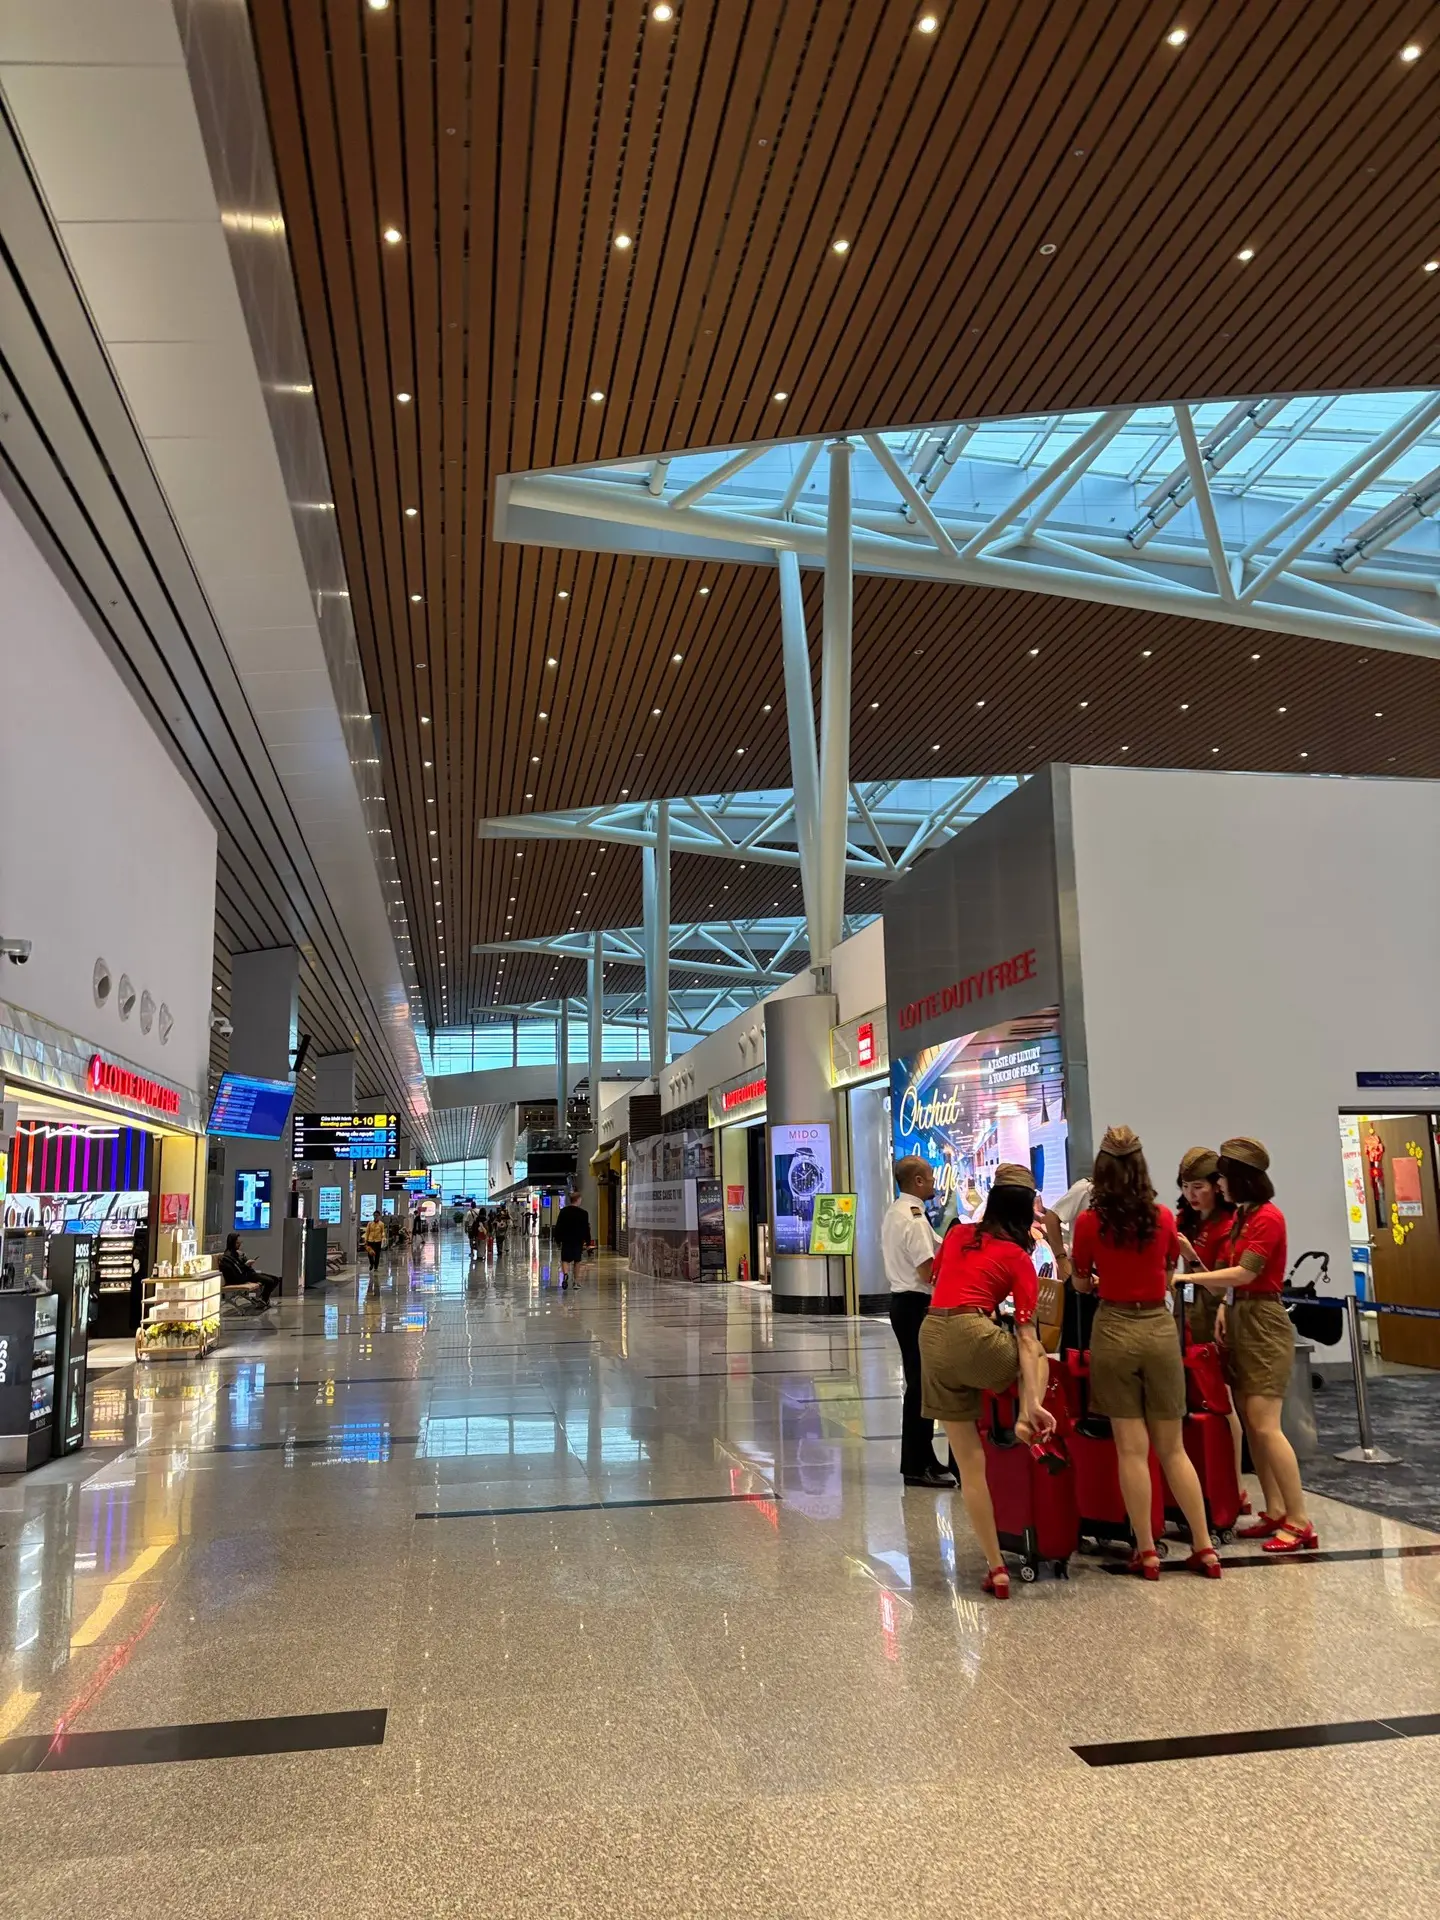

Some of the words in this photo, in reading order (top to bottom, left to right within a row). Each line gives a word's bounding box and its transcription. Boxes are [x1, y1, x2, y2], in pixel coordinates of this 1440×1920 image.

[897, 991, 941, 1032] LOTTE
[941, 971, 985, 1015] DUTY
[987, 948, 1037, 996] FREE
[992, 1055, 1009, 1070] TASTE
[1009, 1053, 1017, 1065] OF
[1017, 1046, 1041, 1063] LUXURY
[993, 1069, 1012, 1083] TOUCH
[1012, 1067, 1020, 1079] OF
[1020, 1062, 1040, 1077] PEACE
[102, 1062, 137, 1098] LOTTE
[137, 1075, 160, 1109] DUTY
[353, 1116, 374, 1126] 6-10
[900, 1085, 962, 1136] Orchid
[789, 1129, 819, 1139] MIDO
[76, 1243, 90, 1258] BOSS
